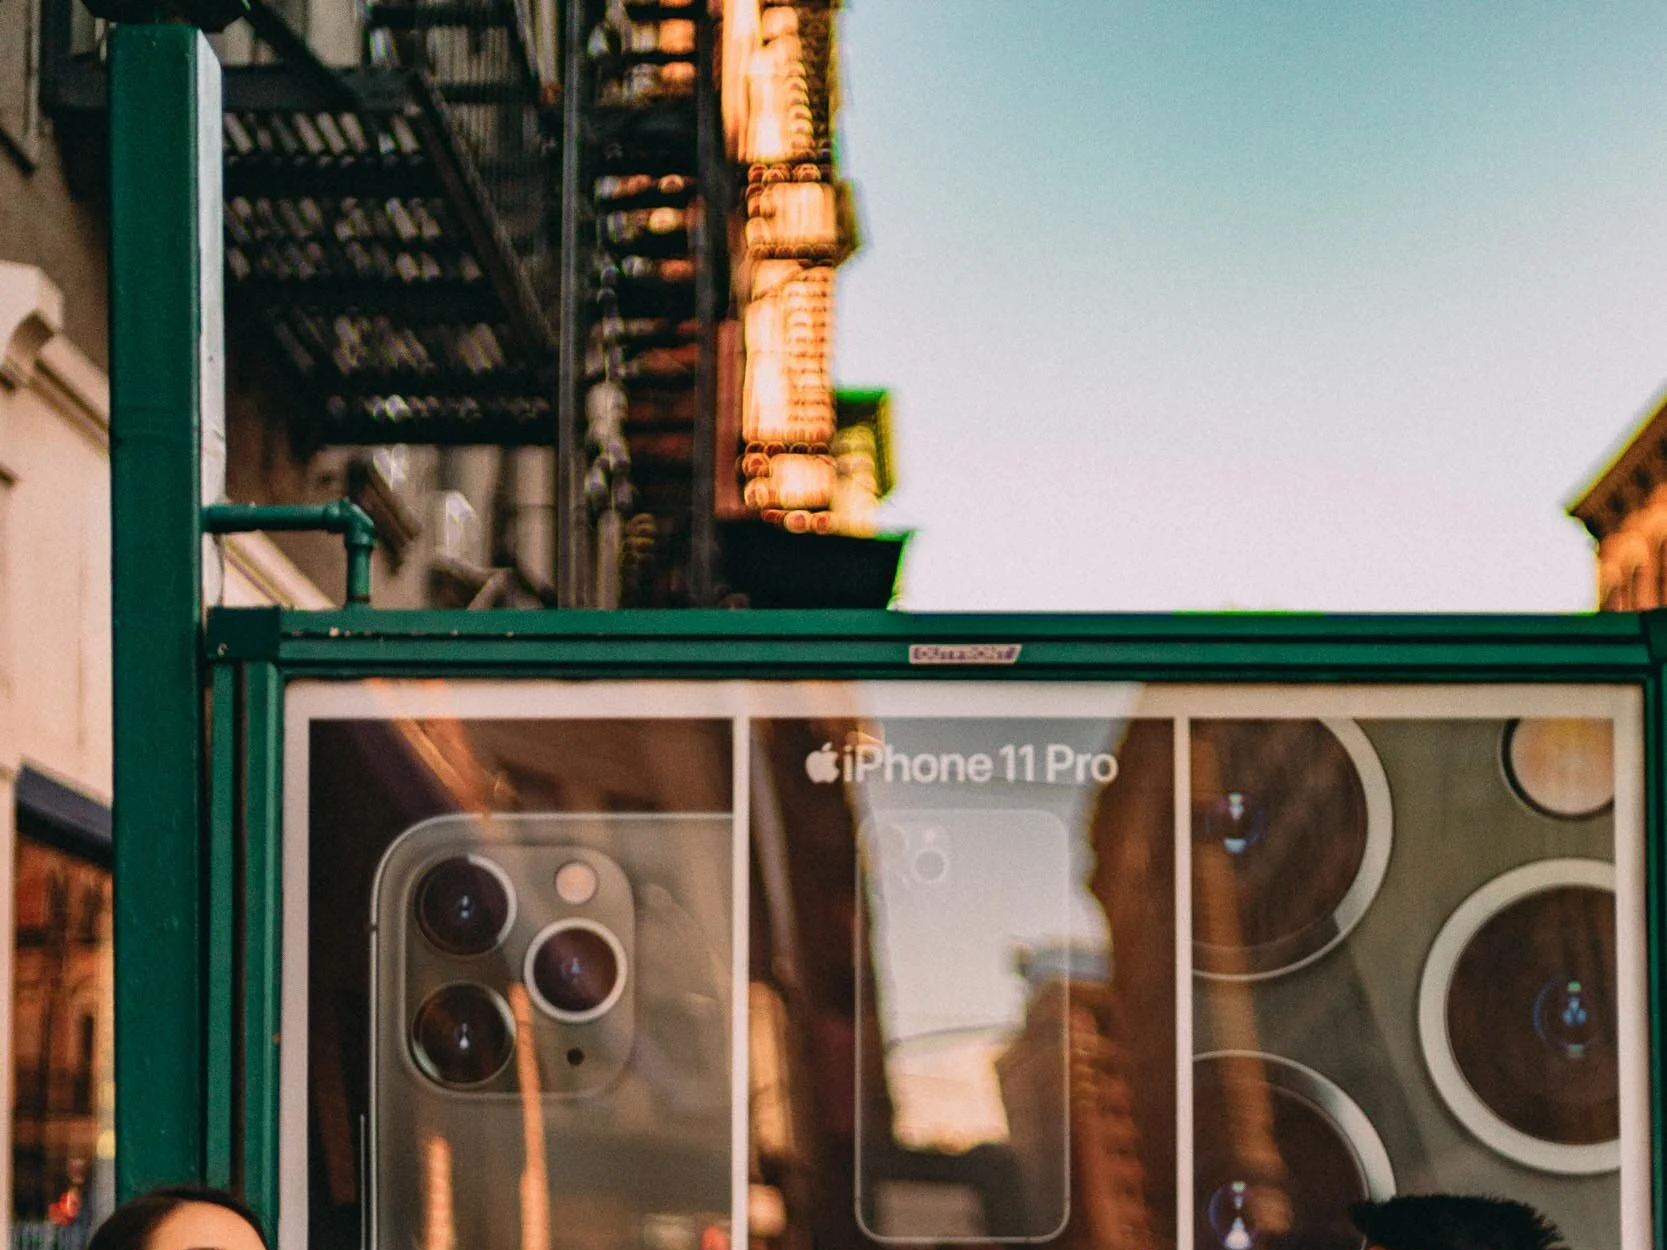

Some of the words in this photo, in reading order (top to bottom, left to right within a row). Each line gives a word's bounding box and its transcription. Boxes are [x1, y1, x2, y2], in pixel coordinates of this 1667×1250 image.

[843, 743, 993, 783] iPhone
[1000, 743, 1035, 782] 11
[1046, 743, 1119, 783] Pro
